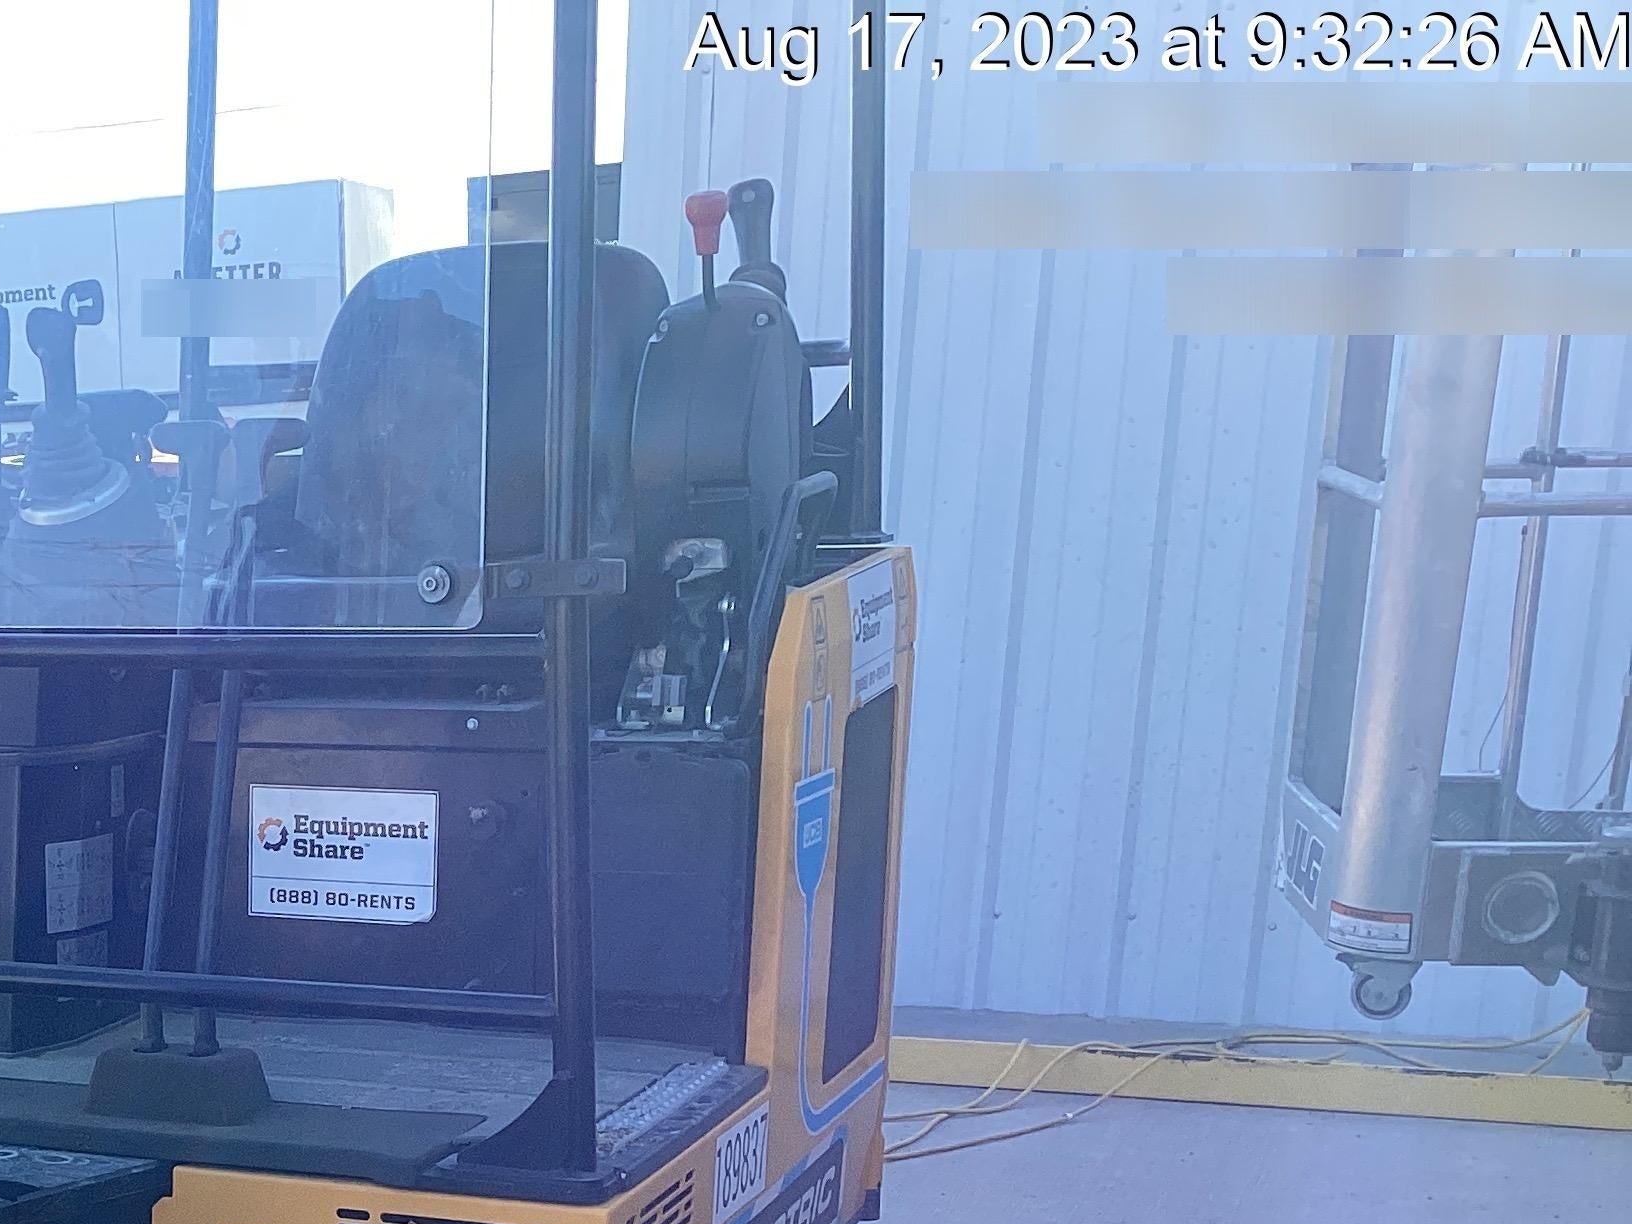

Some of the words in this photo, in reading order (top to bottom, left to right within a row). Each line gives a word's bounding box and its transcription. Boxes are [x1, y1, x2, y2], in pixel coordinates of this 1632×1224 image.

[293, 814, 429, 841] Equipment
[293, 838, 365, 861] Share
[269, 887, 319, 905] (888)
[325, 892, 416, 910] 80-RENTS
[715, 1113, 768, 1214] 189837
